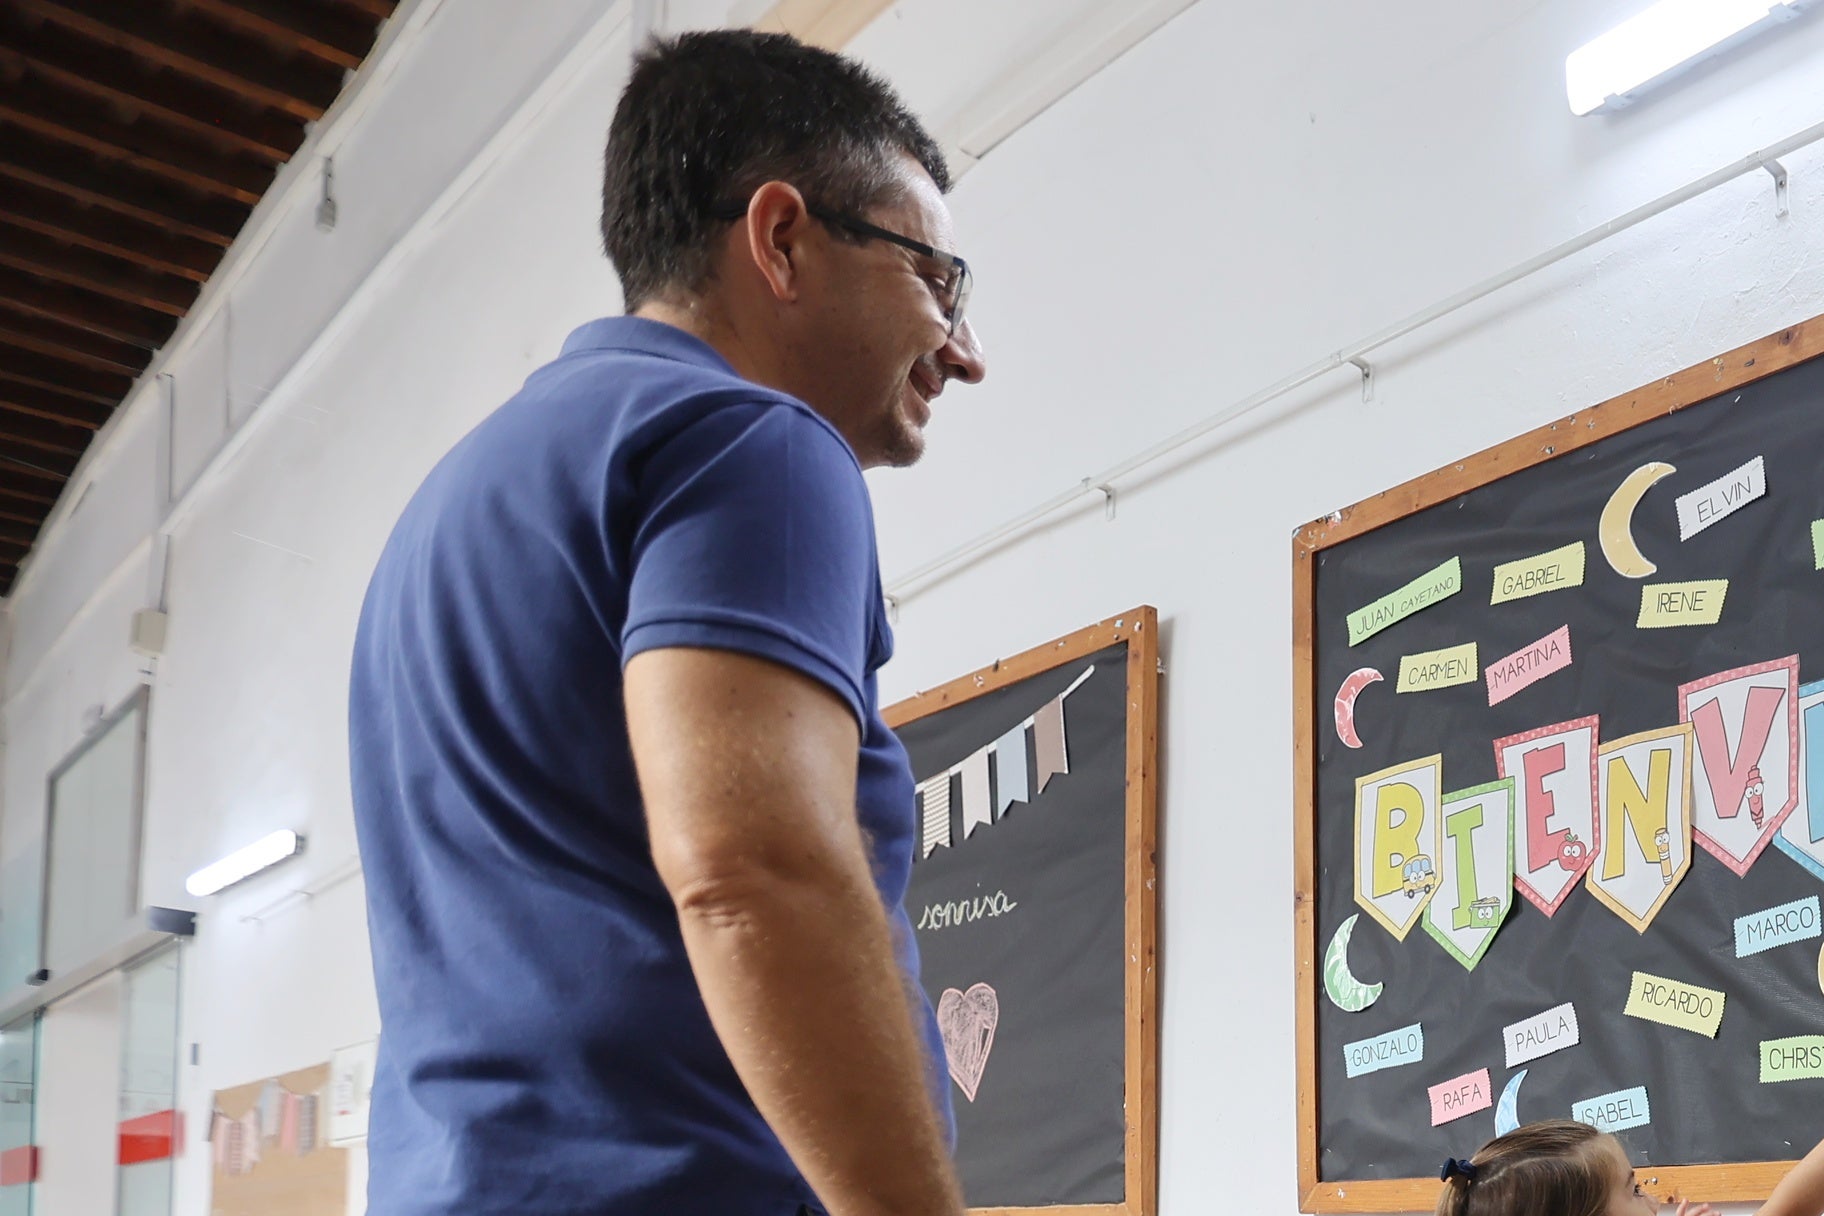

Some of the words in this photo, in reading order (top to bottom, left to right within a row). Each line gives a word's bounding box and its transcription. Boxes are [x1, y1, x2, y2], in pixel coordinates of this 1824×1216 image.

[1696, 476, 1751, 523] ELVIN
[1502, 563, 1566, 595] GABRIEL
[1356, 602, 1395, 635] JUAN
[1400, 576, 1454, 613] CAYETANO
[1656, 590, 1708, 614] IRENE
[1408, 657, 1469, 685] CARMEN
[1493, 639, 1561, 689] MARTINA
[917, 882, 1018, 931] sonrisa
[1746, 905, 1815, 944] MARCO
[1640, 981, 1714, 1019] RICARDO
[1351, 1033, 1419, 1067] GONZALO
[1514, 1015, 1571, 1052] PAULA
[1442, 1082, 1483, 1112] RAFA
[1581, 1097, 1643, 1130] ISABEL
